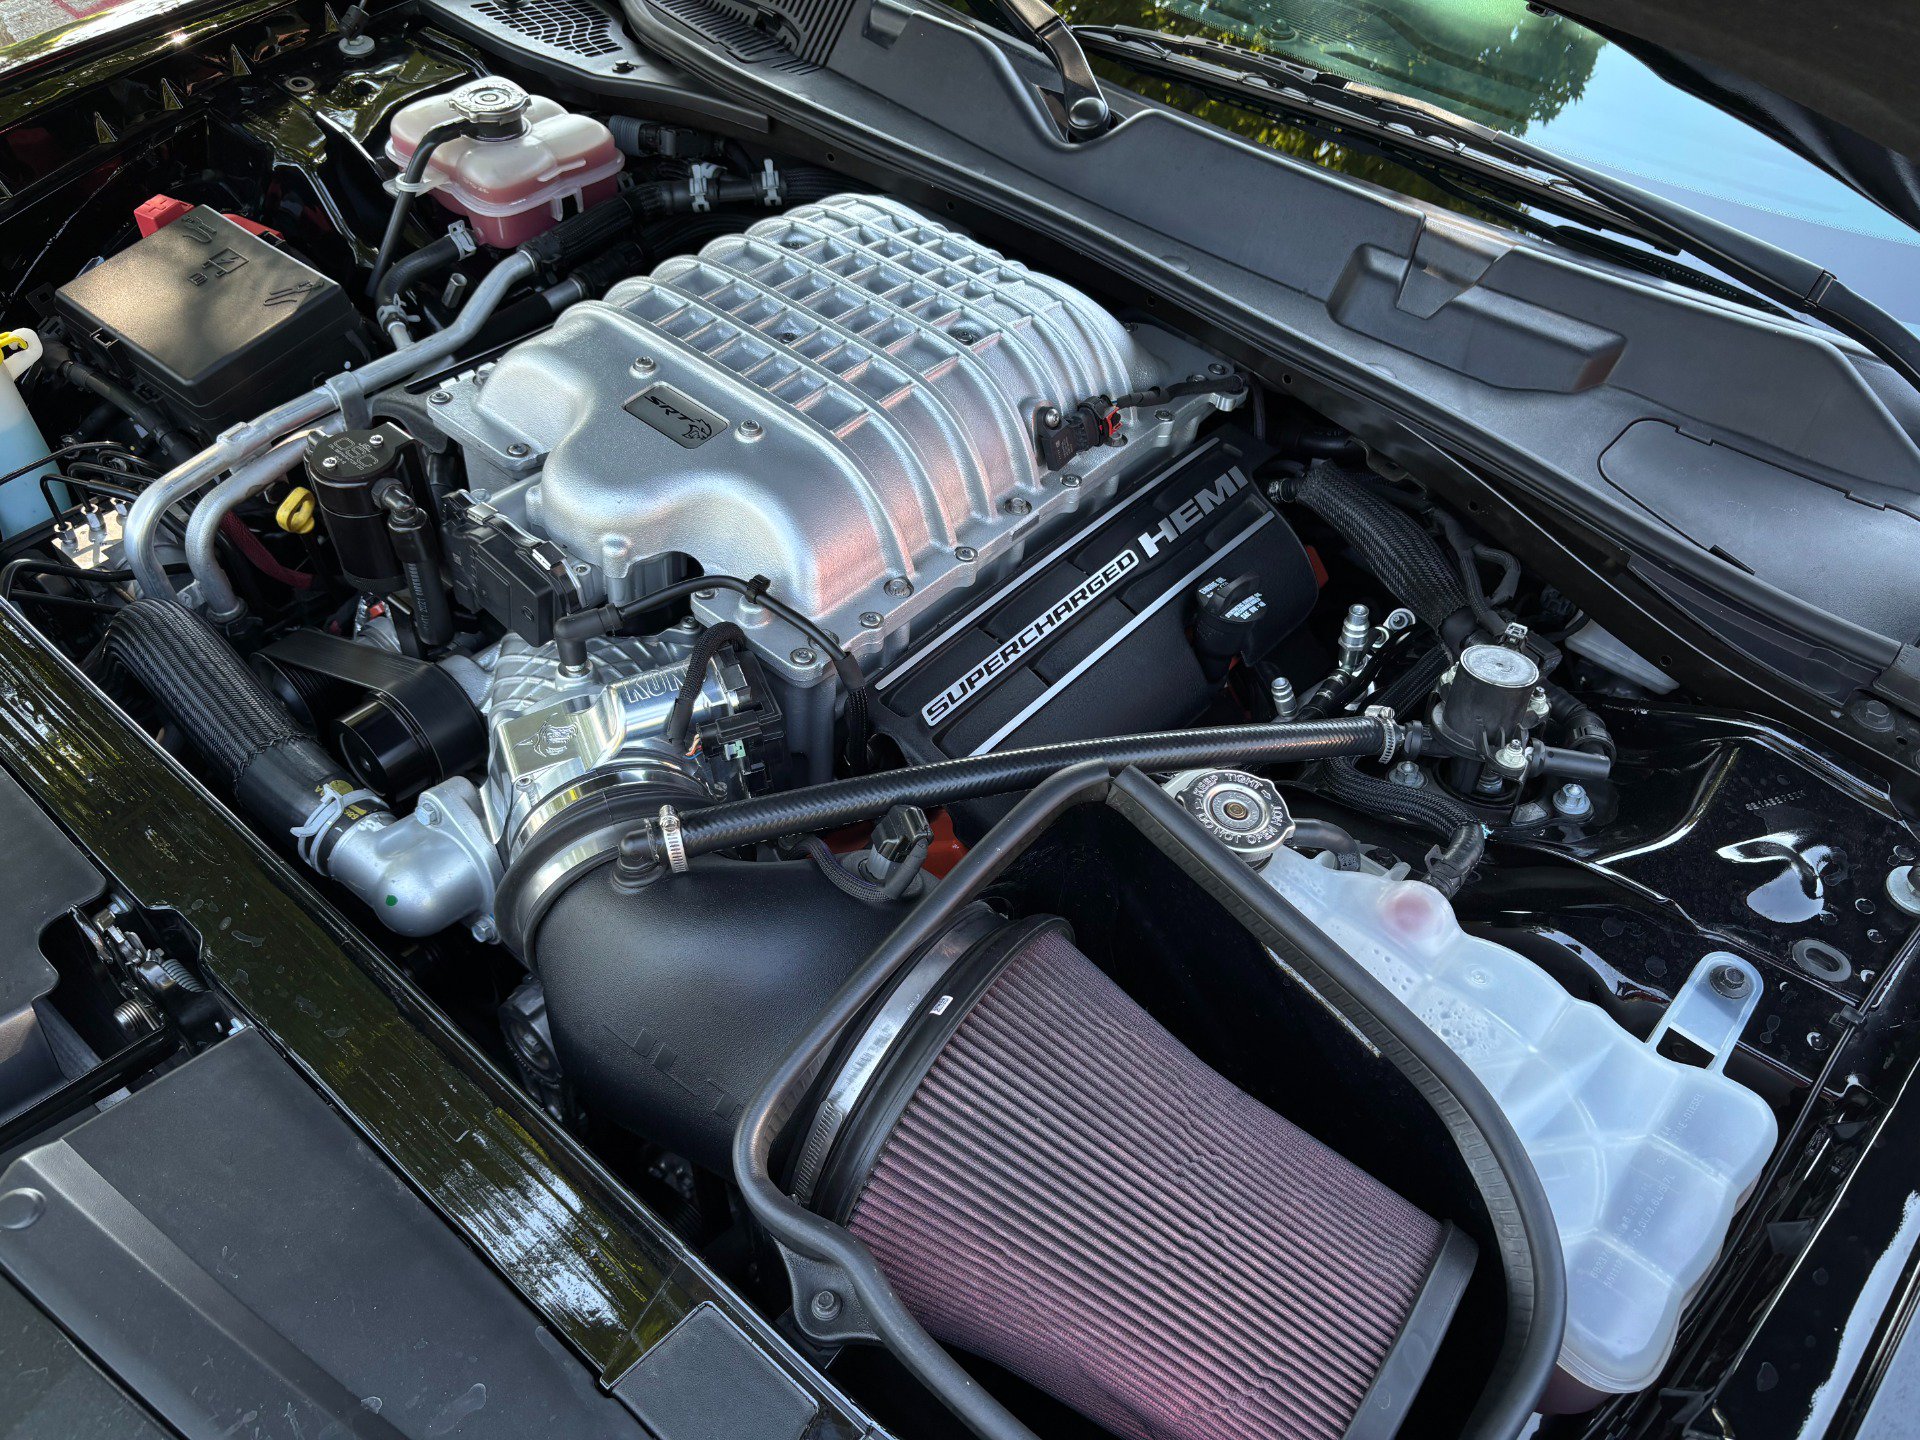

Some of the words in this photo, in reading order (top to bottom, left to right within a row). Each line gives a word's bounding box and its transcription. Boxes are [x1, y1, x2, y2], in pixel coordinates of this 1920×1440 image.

[643, 395, 696, 423] SRT
[923, 550, 1139, 725] SUPERCHARGED
[1138, 466, 1249, 559] HEMI
[1192, 774, 1219, 797] KEEP
[1224, 773, 1263, 790] TIGHT
[1196, 812, 1214, 829] DO
[1213, 827, 1242, 844] NOT
[1246, 825, 1278, 845] OPEN
[1270, 803, 1284, 827] HOT
